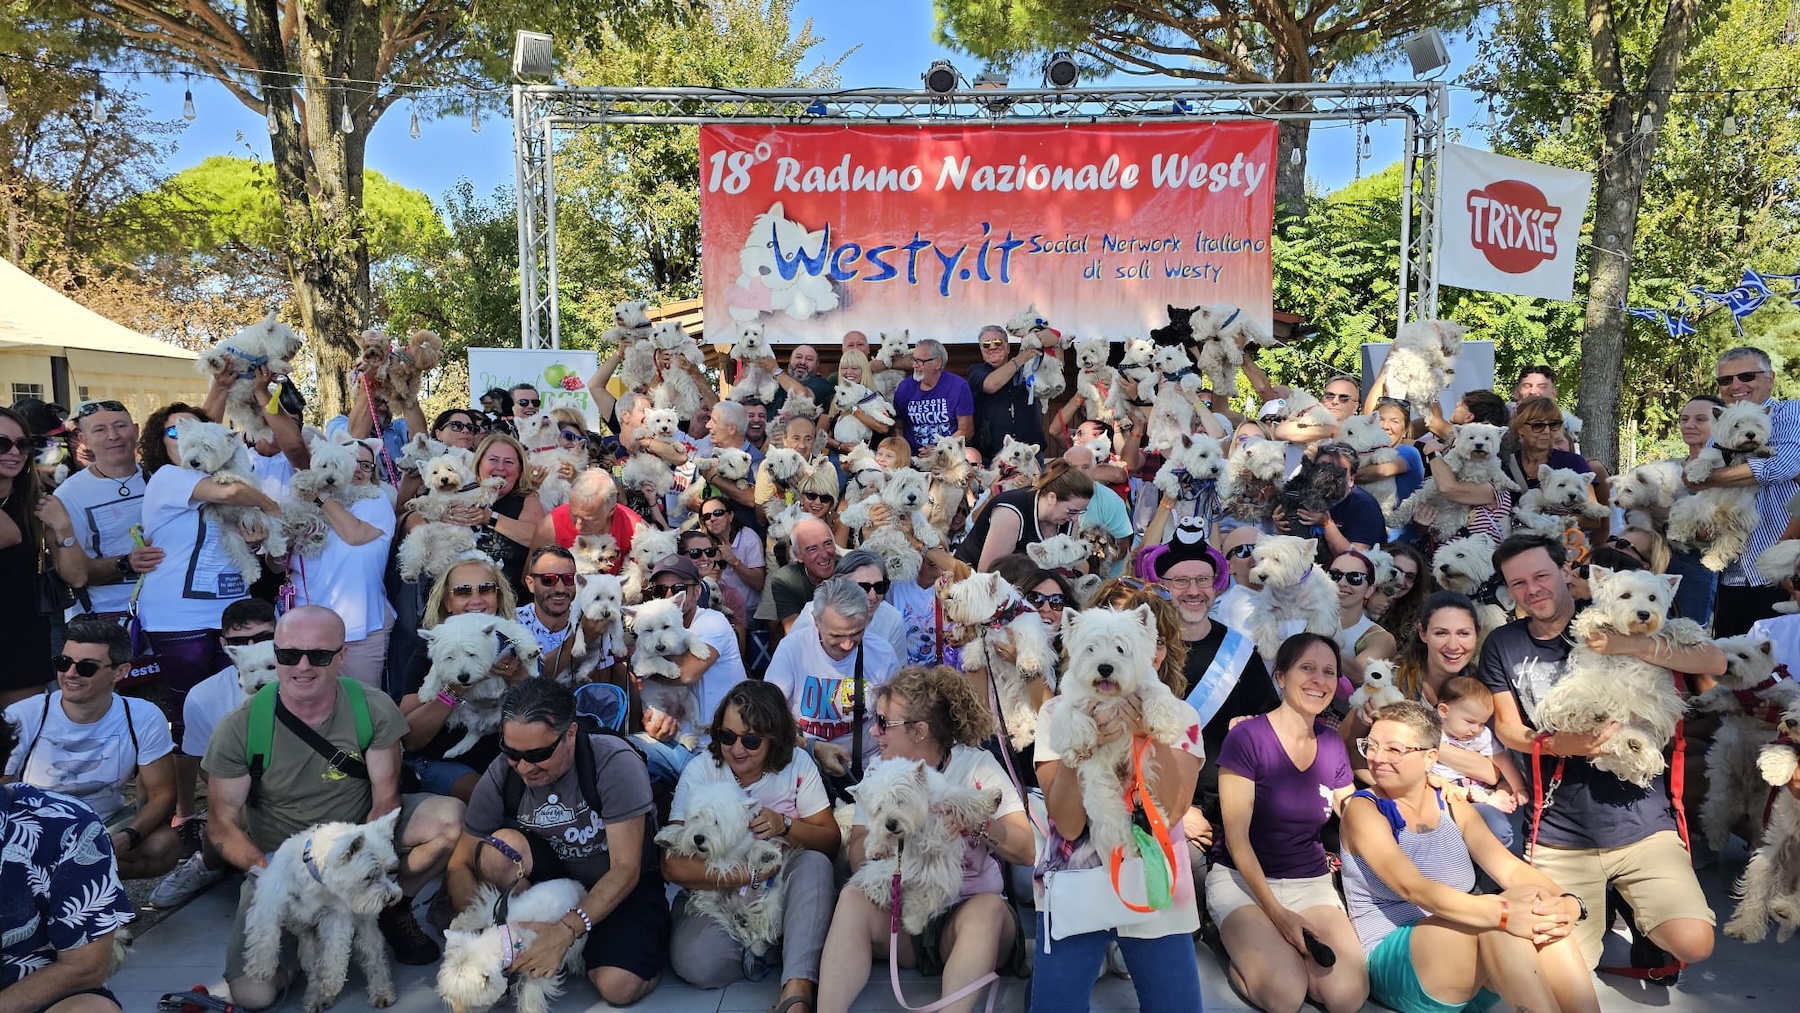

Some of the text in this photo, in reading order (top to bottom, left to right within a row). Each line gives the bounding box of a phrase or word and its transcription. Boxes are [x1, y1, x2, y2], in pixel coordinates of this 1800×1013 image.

[773, 153, 923, 193] Raduno
[935, 153, 1140, 193] Nazionale
[1151, 152, 1267, 197] Westy
[1028, 230, 1267, 255] Social Network Italiano
[772, 220, 1026, 298] Westy.it
[1083, 258, 1224, 284] di soli Westy
[907, 403, 947, 413] WESTIE
[907, 411, 950, 424] TRICKS
[130, 662, 160, 678] esti
[801, 675, 842, 720] OK
